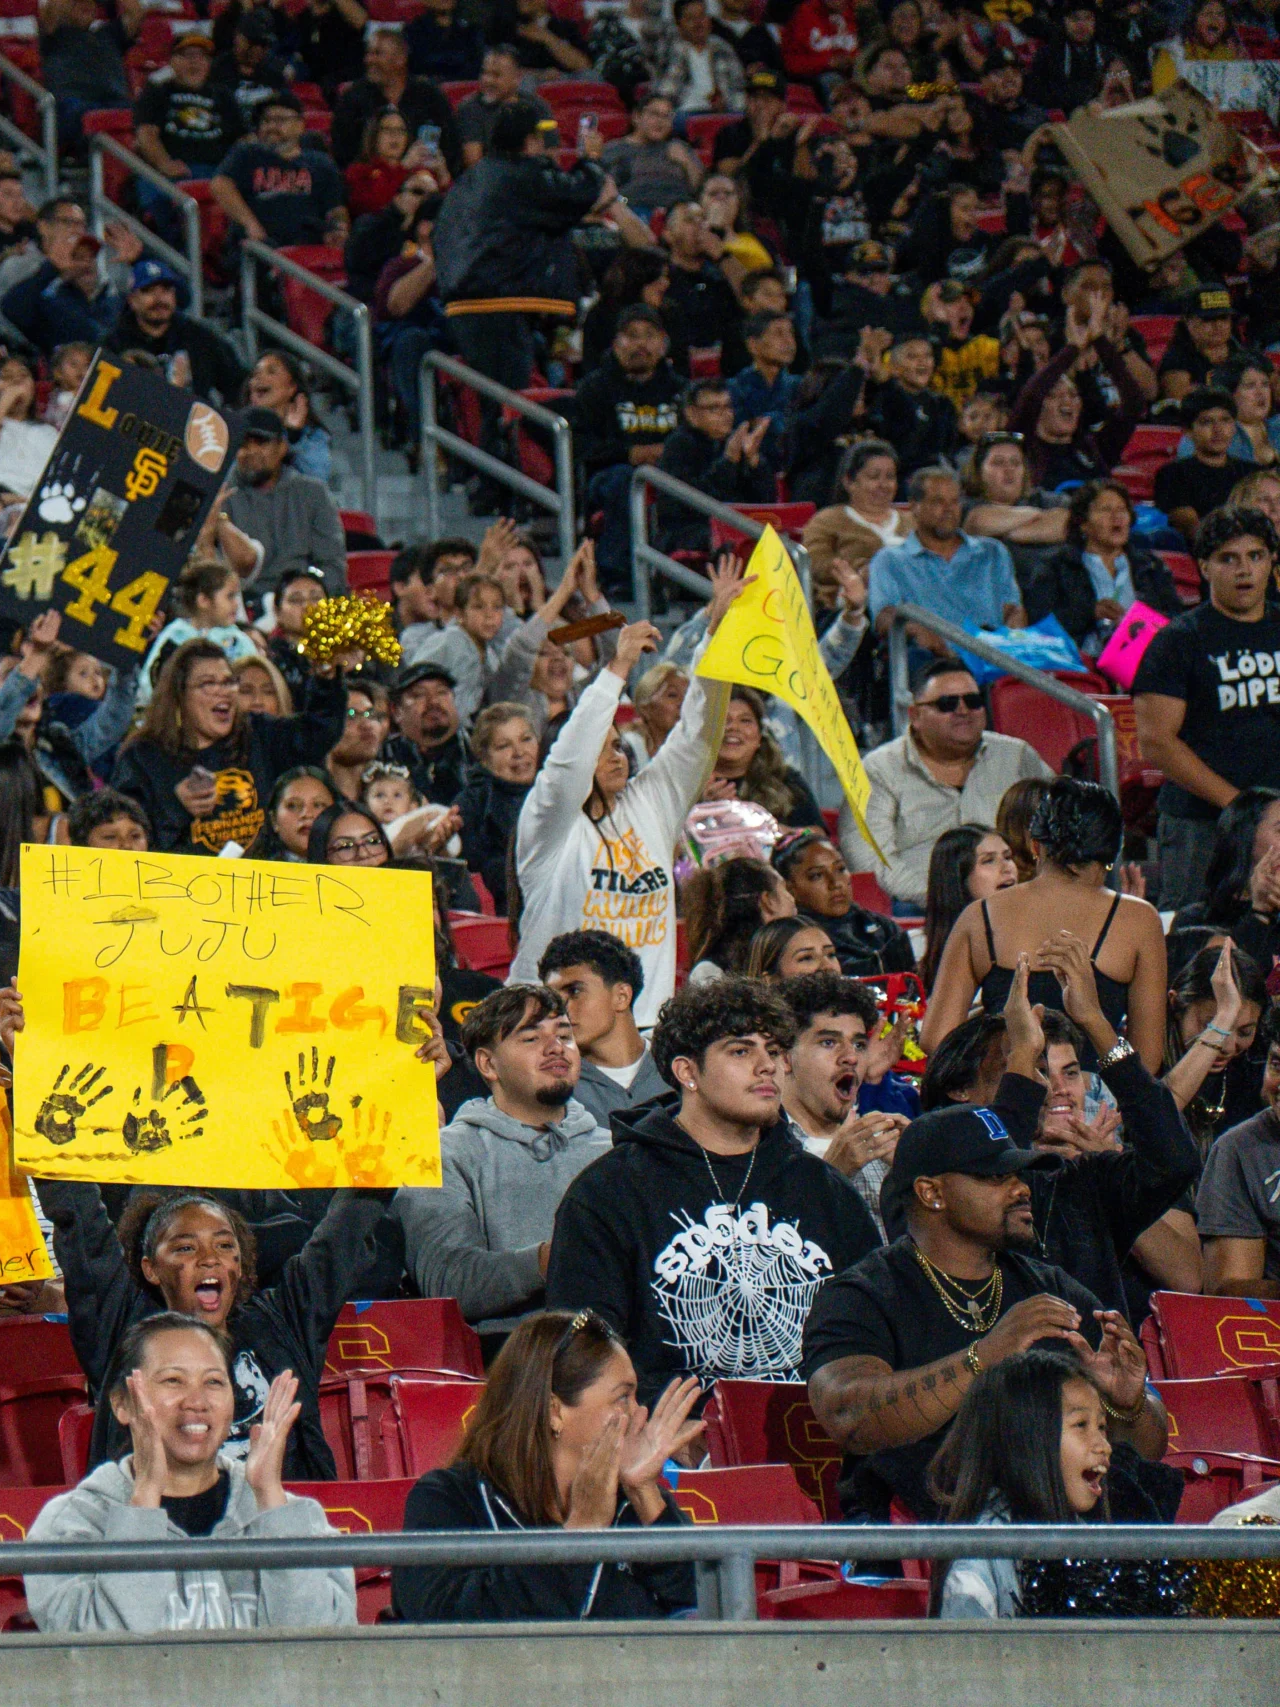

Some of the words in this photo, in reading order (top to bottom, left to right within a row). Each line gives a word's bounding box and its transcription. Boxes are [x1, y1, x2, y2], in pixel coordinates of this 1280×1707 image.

[1, 531, 170, 653] #44
[1216, 649, 1280, 682] LÖD
[135, 859, 372, 927] BOTHER
[62, 975, 160, 1036] BE
[172, 974, 217, 1032] A
[973, 1108, 1009, 1141] D
